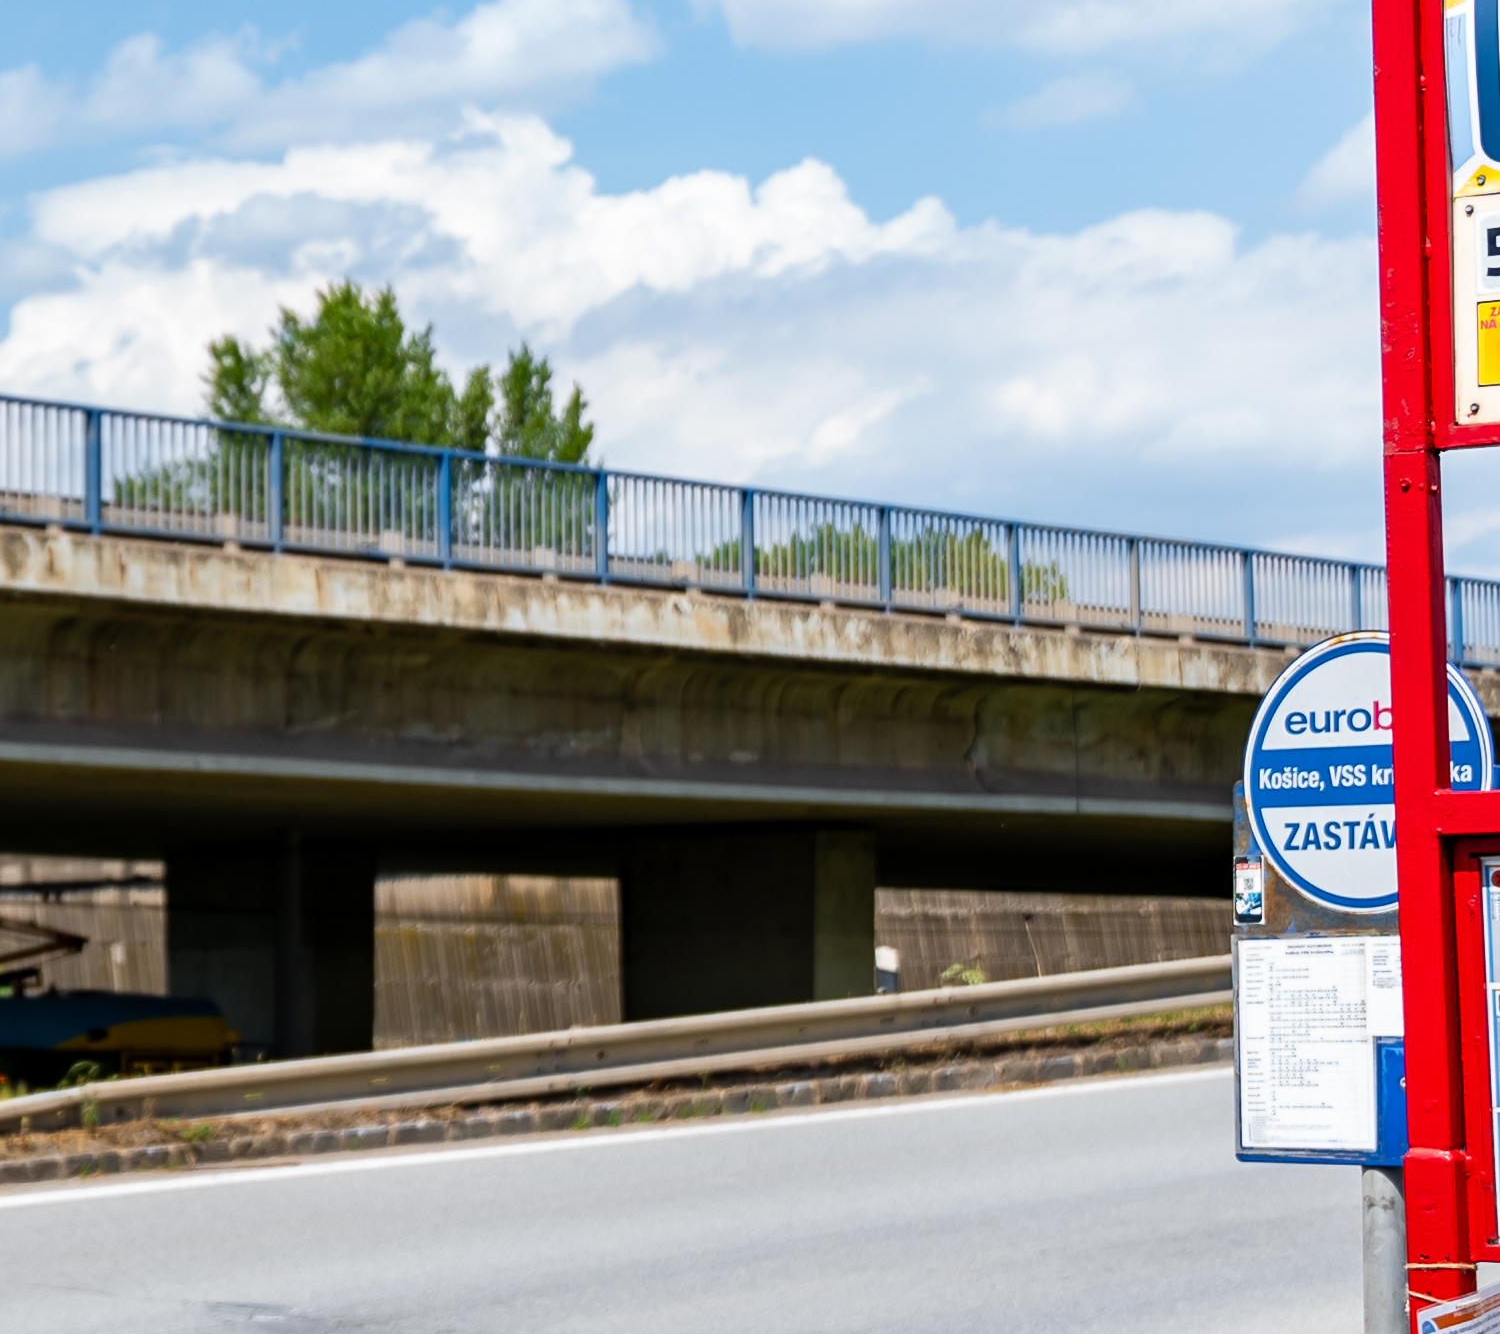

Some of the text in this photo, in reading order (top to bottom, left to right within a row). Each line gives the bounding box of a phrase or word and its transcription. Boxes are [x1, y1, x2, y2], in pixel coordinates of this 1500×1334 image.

[1480, 319, 1498, 330] NA
[1284, 700, 1394, 735] eurob
[1259, 766, 1325, 792] Košice,
[1328, 763, 1367, 787] VSS
[1283, 812, 1396, 851] ZASTÁV
